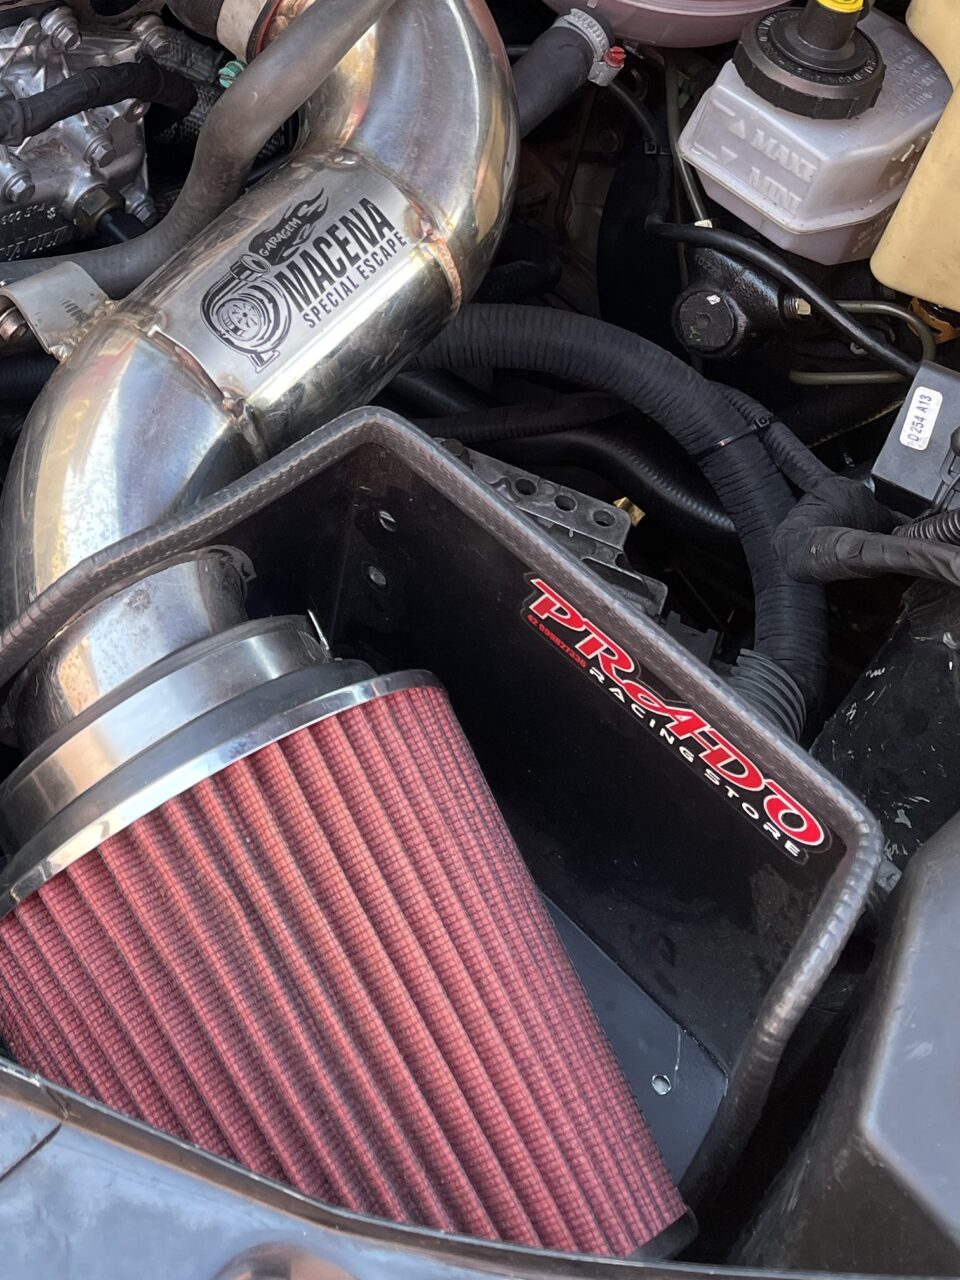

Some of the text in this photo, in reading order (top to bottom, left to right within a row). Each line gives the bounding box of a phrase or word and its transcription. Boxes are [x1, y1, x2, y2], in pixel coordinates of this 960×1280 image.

[749, 166, 802, 215] MINI
[750, 128, 817, 183] MAXI
[258, 217, 303, 258] GARAGEM
[274, 197, 395, 314] MACENA
[302, 230, 408, 329] SPECIAL ESCAPE
[910, 415, 927, 434] 254
[528, 578, 825, 846] PRADO
[589, 666, 800, 857] RACING STORE
